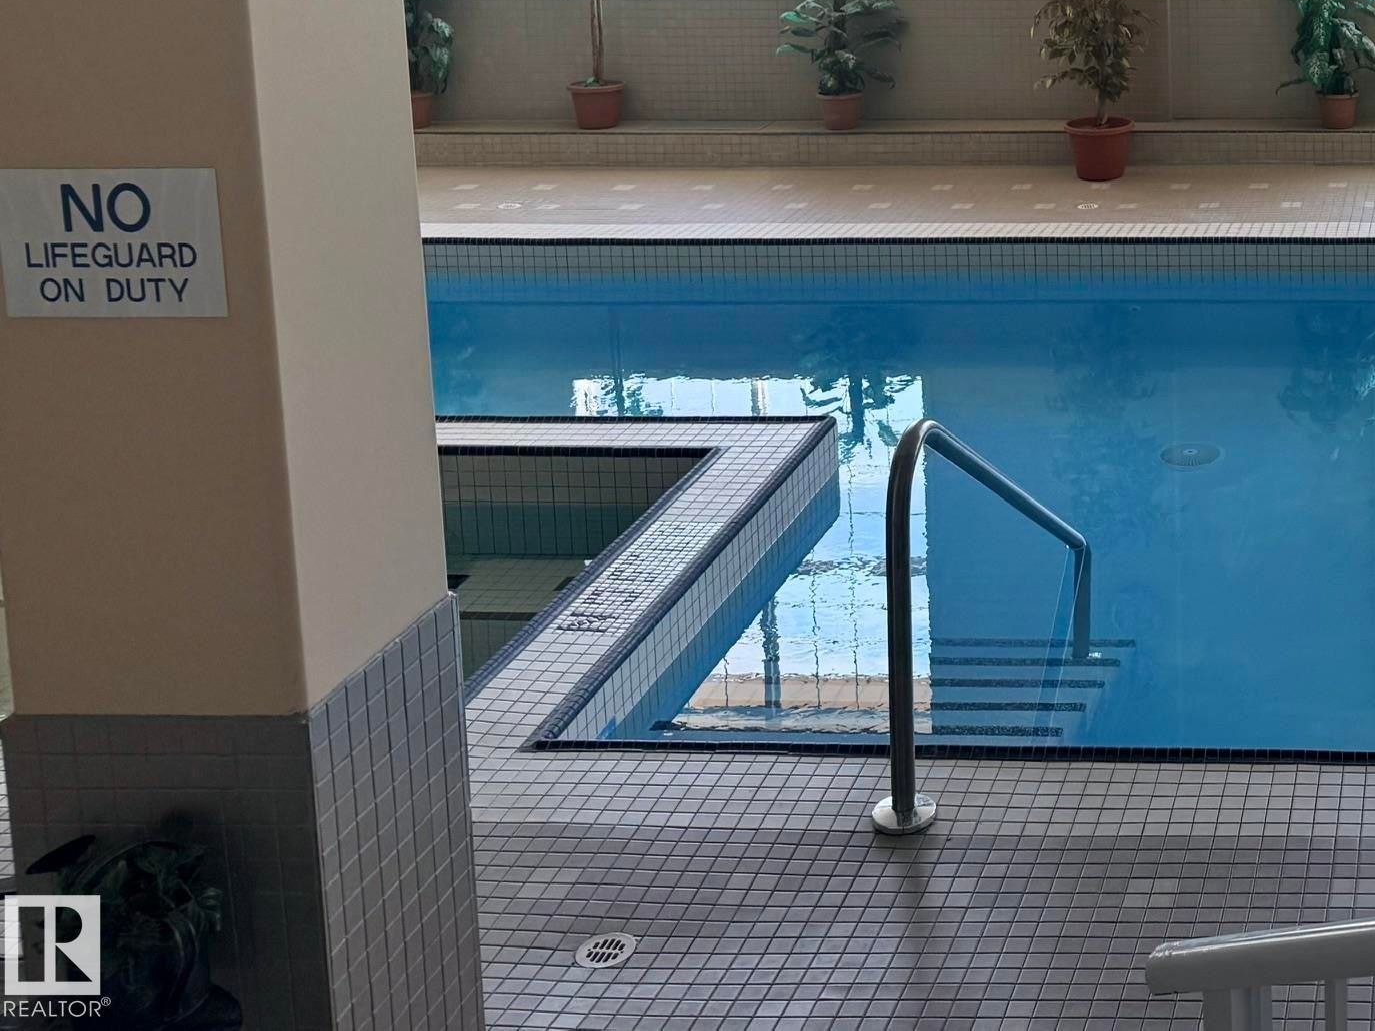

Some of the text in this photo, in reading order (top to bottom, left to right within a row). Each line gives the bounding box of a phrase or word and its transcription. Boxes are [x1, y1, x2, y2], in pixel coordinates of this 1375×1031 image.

[60, 182, 151, 233] NO
[25, 242, 197, 268] LIFEGUARD
[40, 277, 189, 302] ON DUTY
